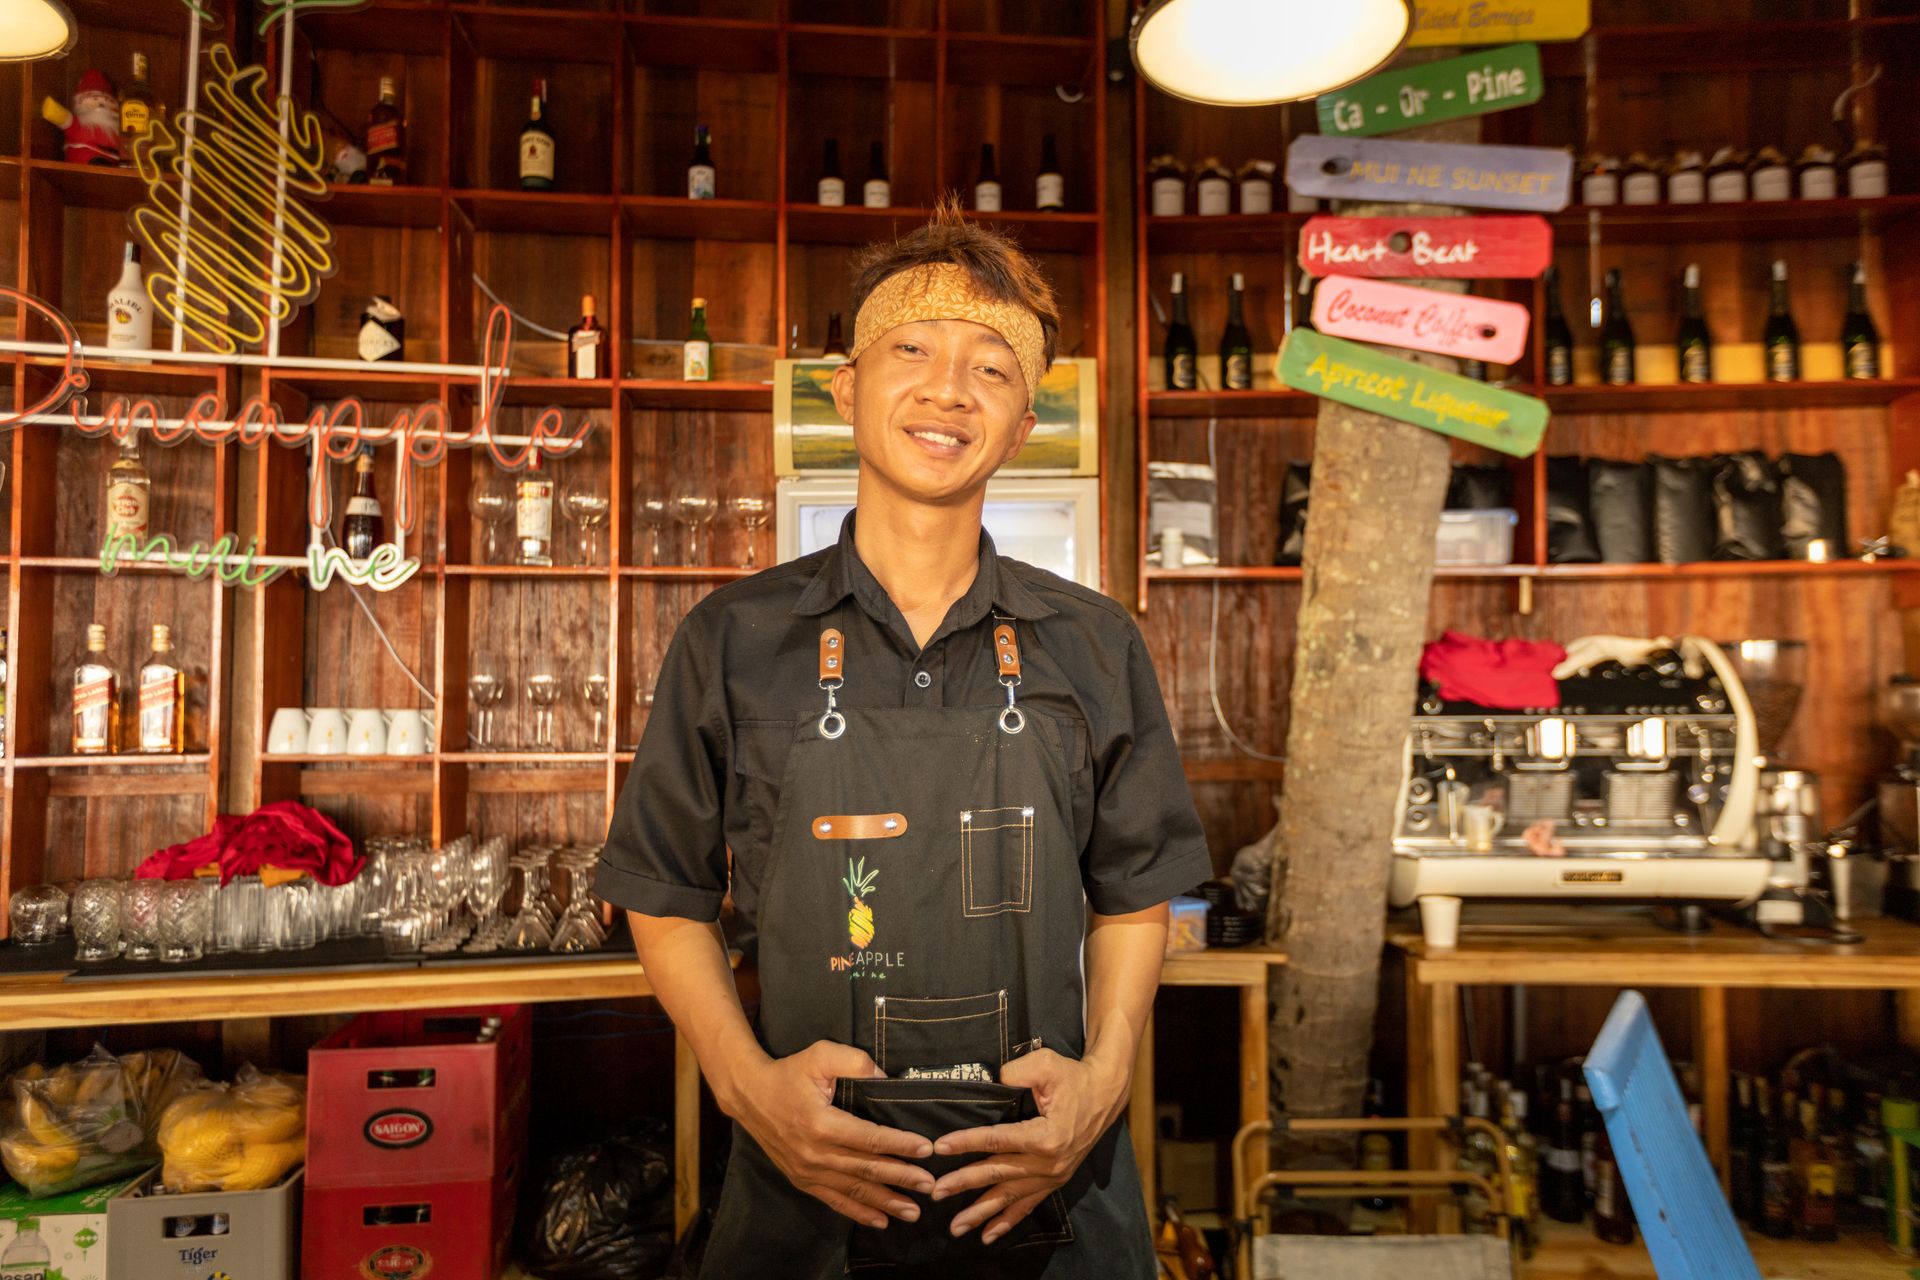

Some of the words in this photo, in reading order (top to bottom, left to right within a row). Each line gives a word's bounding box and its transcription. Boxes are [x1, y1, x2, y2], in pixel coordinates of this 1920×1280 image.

[1334, 99, 1364, 131] Ca
[1400, 84, 1430, 117] Or
[1466, 65, 1527, 104] Pine
[1350, 159, 1399, 184] MUI
[1407, 164, 1444, 188] NE
[1451, 166, 1554, 195] SUNSET
[1308, 230, 1390, 264] Heart
[1412, 231, 1480, 265] Beat
[1327, 288, 1409, 328] Coconut
[1306, 352, 1409, 401] Apricot
[101, 521, 279, 586] mui
[309, 543, 420, 587] ne
[830, 951, 905, 971] PINEAPPLE
[375, 1122, 420, 1135] SAIGON
[179, 1247, 218, 1265] Tiger
